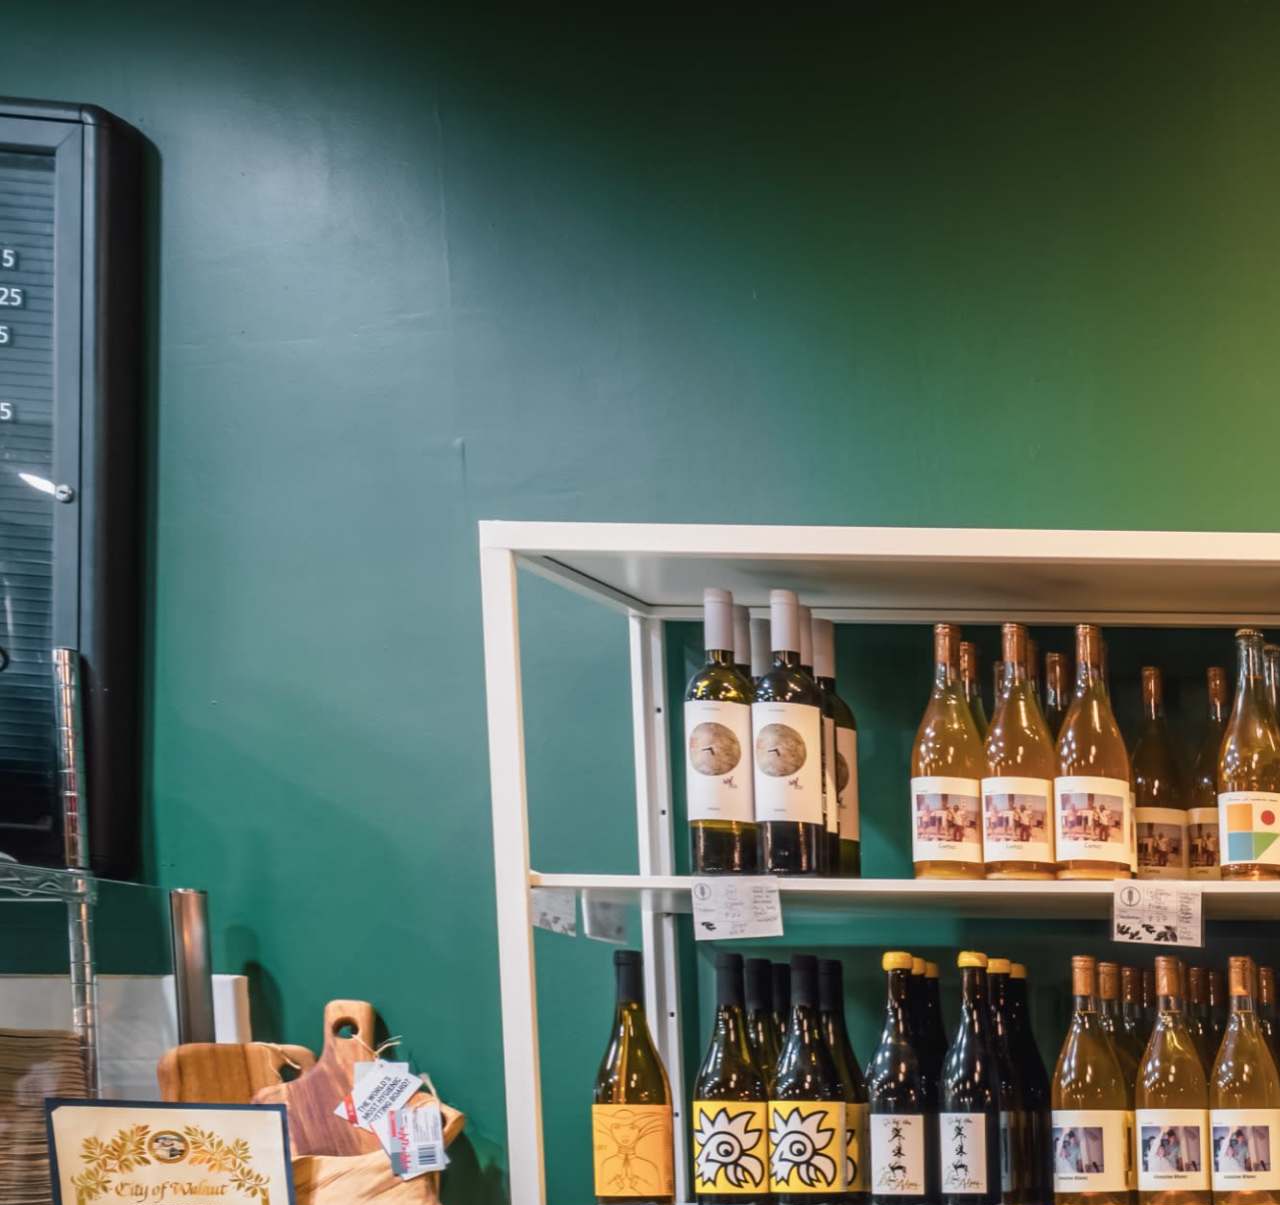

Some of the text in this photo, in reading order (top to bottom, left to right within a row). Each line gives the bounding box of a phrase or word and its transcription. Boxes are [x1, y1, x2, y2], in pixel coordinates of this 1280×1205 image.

[114, 1179, 228, 1203] City of Walnut
